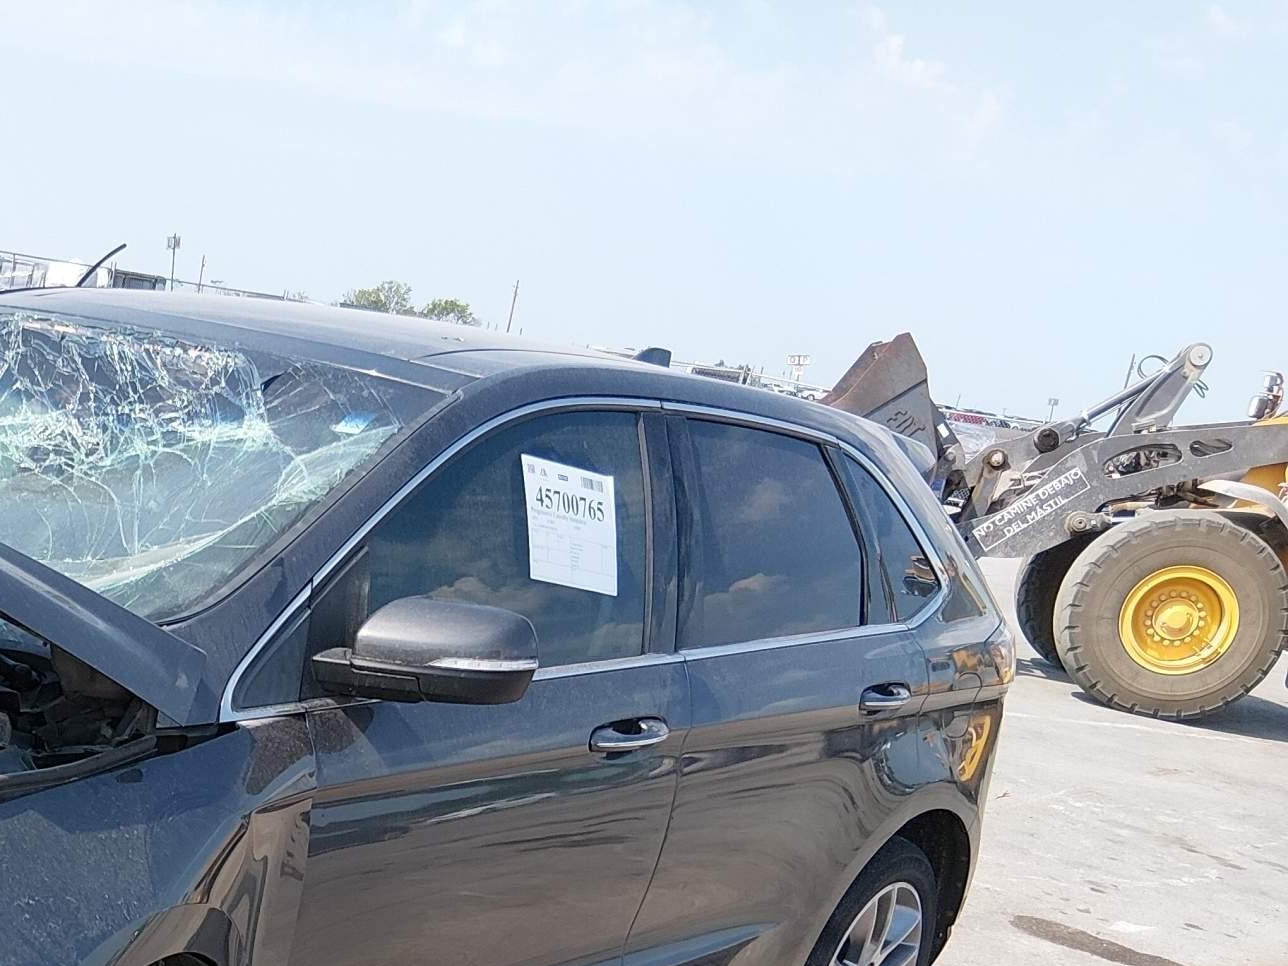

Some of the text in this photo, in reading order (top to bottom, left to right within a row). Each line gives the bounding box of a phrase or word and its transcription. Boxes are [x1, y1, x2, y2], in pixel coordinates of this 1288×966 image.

[535, 485, 605, 522] 45700765
[974, 469, 1082, 539] NO CAMINE DEBAJO
[1003, 520, 1027, 538] DEL
